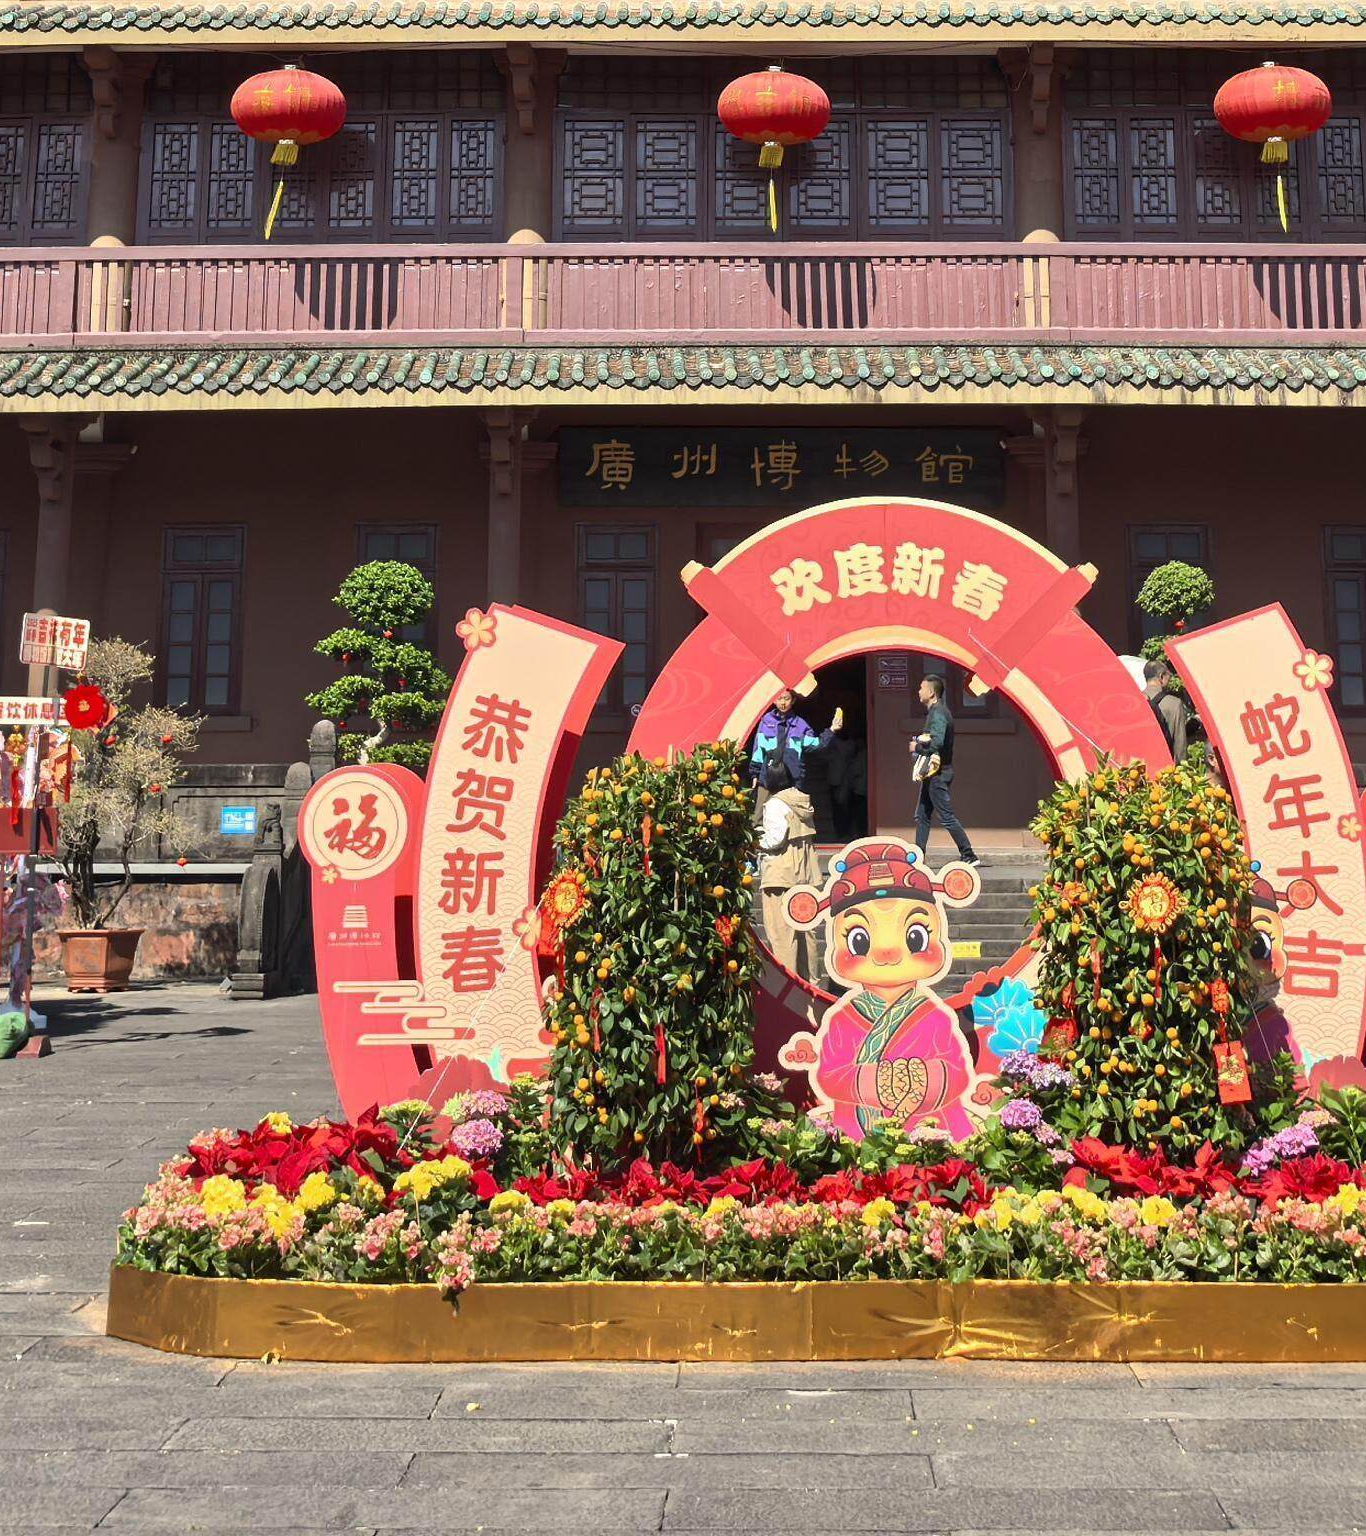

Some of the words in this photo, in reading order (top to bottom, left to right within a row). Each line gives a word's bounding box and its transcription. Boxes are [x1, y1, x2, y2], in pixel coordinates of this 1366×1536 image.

[585, 439, 973, 491] 廣州博物館
[769, 541, 1009, 622] 欢度新春
[323, 792, 387, 860] 福
[437, 692, 533, 993] 恭贺新春
[1239, 692, 1345, 999] 蛇年大吉
